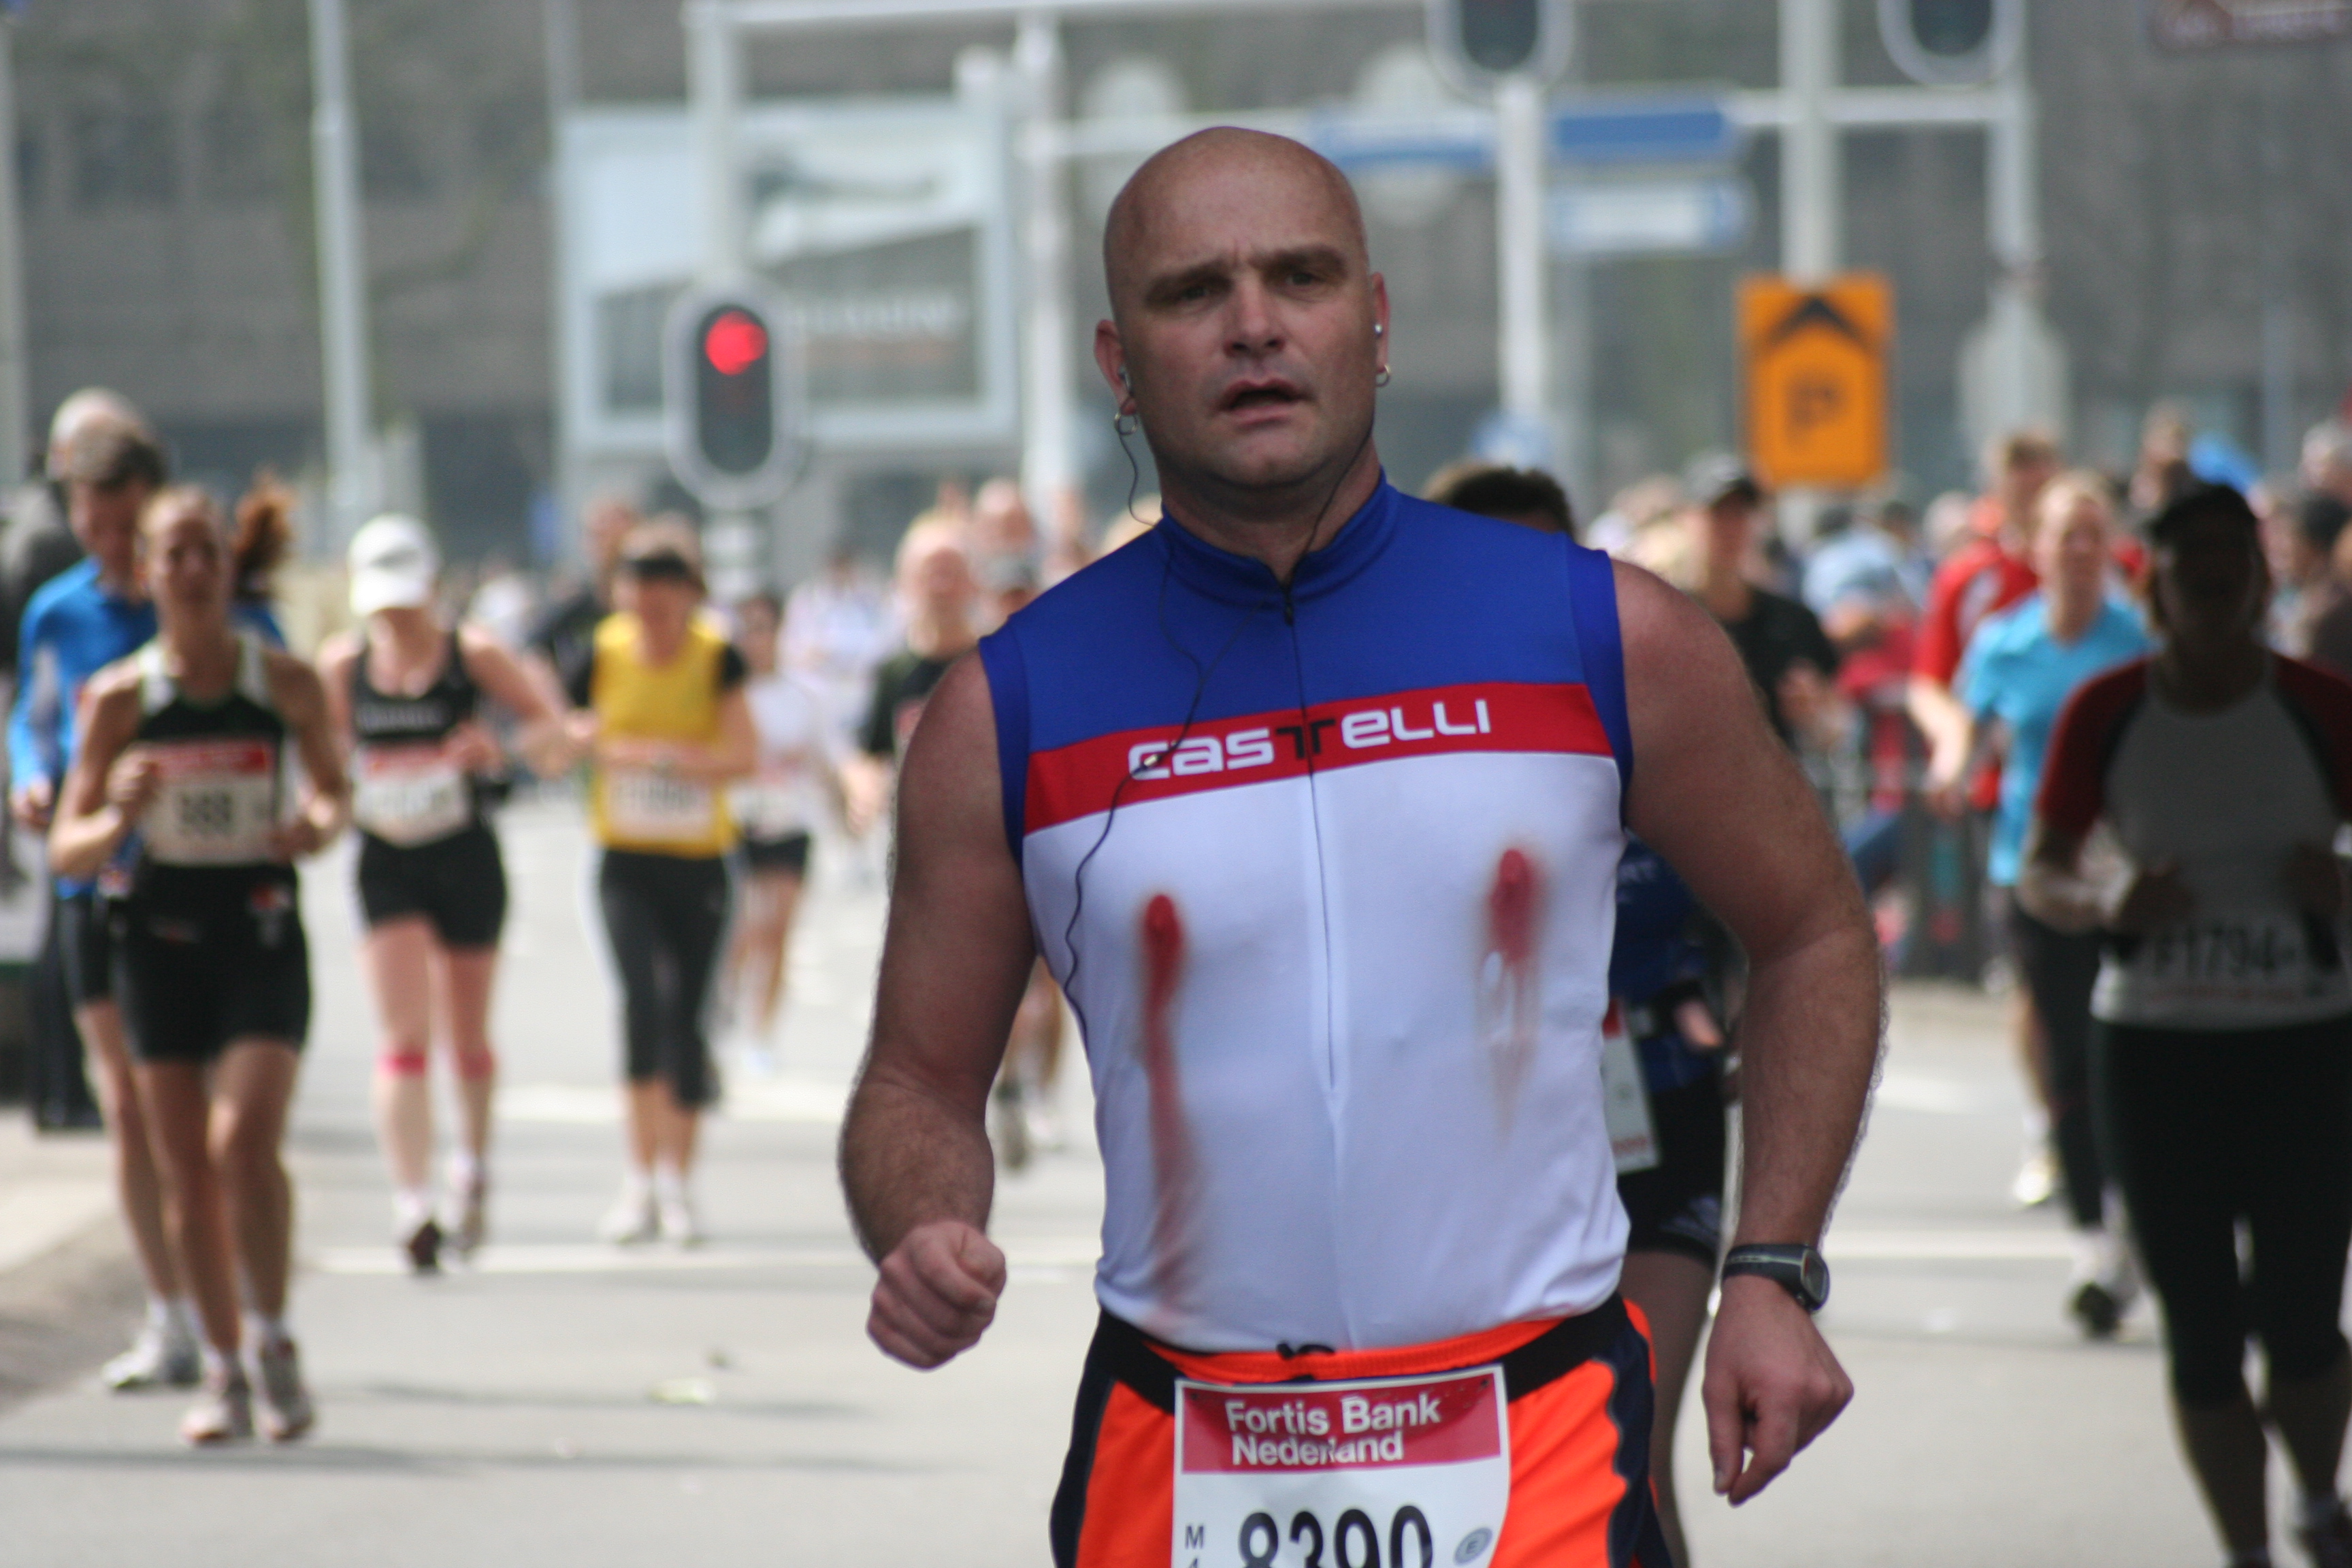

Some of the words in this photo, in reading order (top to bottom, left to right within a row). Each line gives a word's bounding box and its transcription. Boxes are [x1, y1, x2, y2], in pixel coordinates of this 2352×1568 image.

[1226, 1399, 1330, 1436] Fortis
[1341, 1392, 1441, 1433] Bank
[1232, 1428, 1403, 1466] Nederland
[1184, 1525, 1204, 1549] M
[1238, 1505, 1433, 1568] 8390
